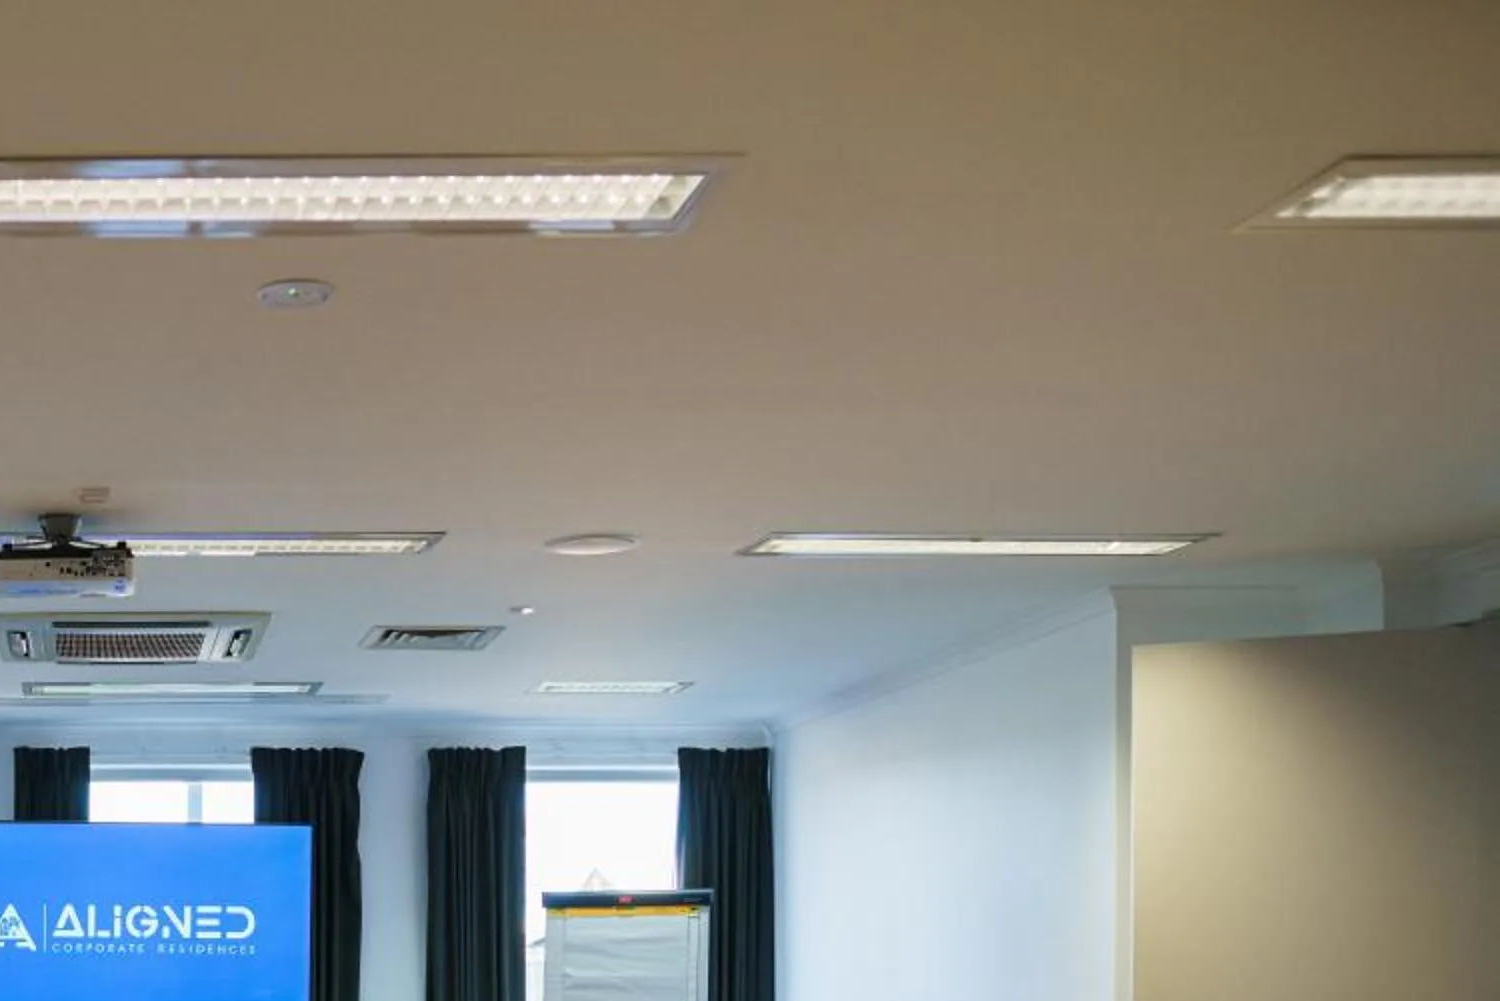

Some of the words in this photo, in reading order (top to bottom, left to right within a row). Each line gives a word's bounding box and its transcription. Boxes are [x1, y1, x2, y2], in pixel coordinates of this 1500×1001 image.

[52, 903, 256, 940] ALIGNED
[51, 943, 146, 954] CORPORATE
[156, 943, 257, 956] RESIDENCES
